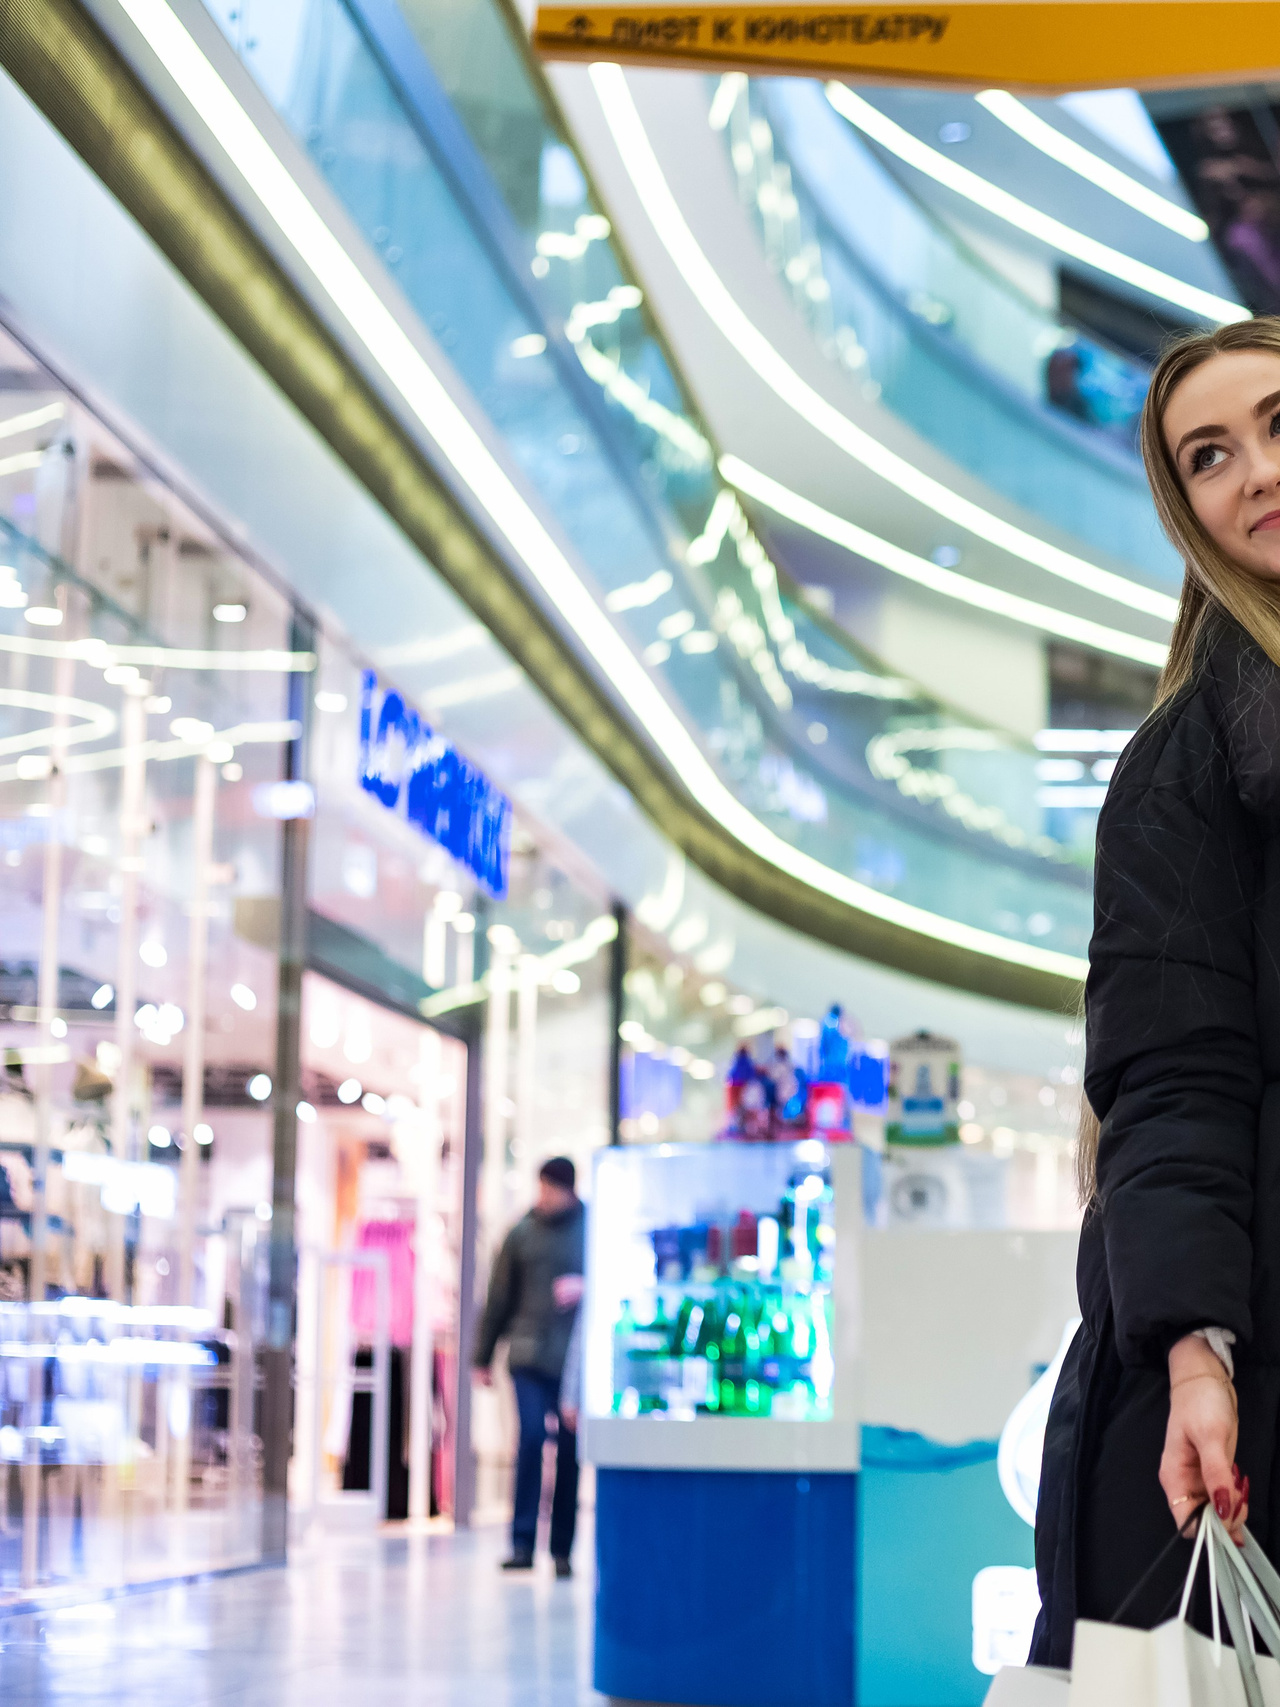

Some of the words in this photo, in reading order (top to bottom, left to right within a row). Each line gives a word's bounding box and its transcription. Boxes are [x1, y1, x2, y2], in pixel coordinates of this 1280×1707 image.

[611, 15, 703, 46] ЛИФТ
[713, 15, 737, 43] К
[745, 14, 950, 44] КИНОТЕАТРУ
